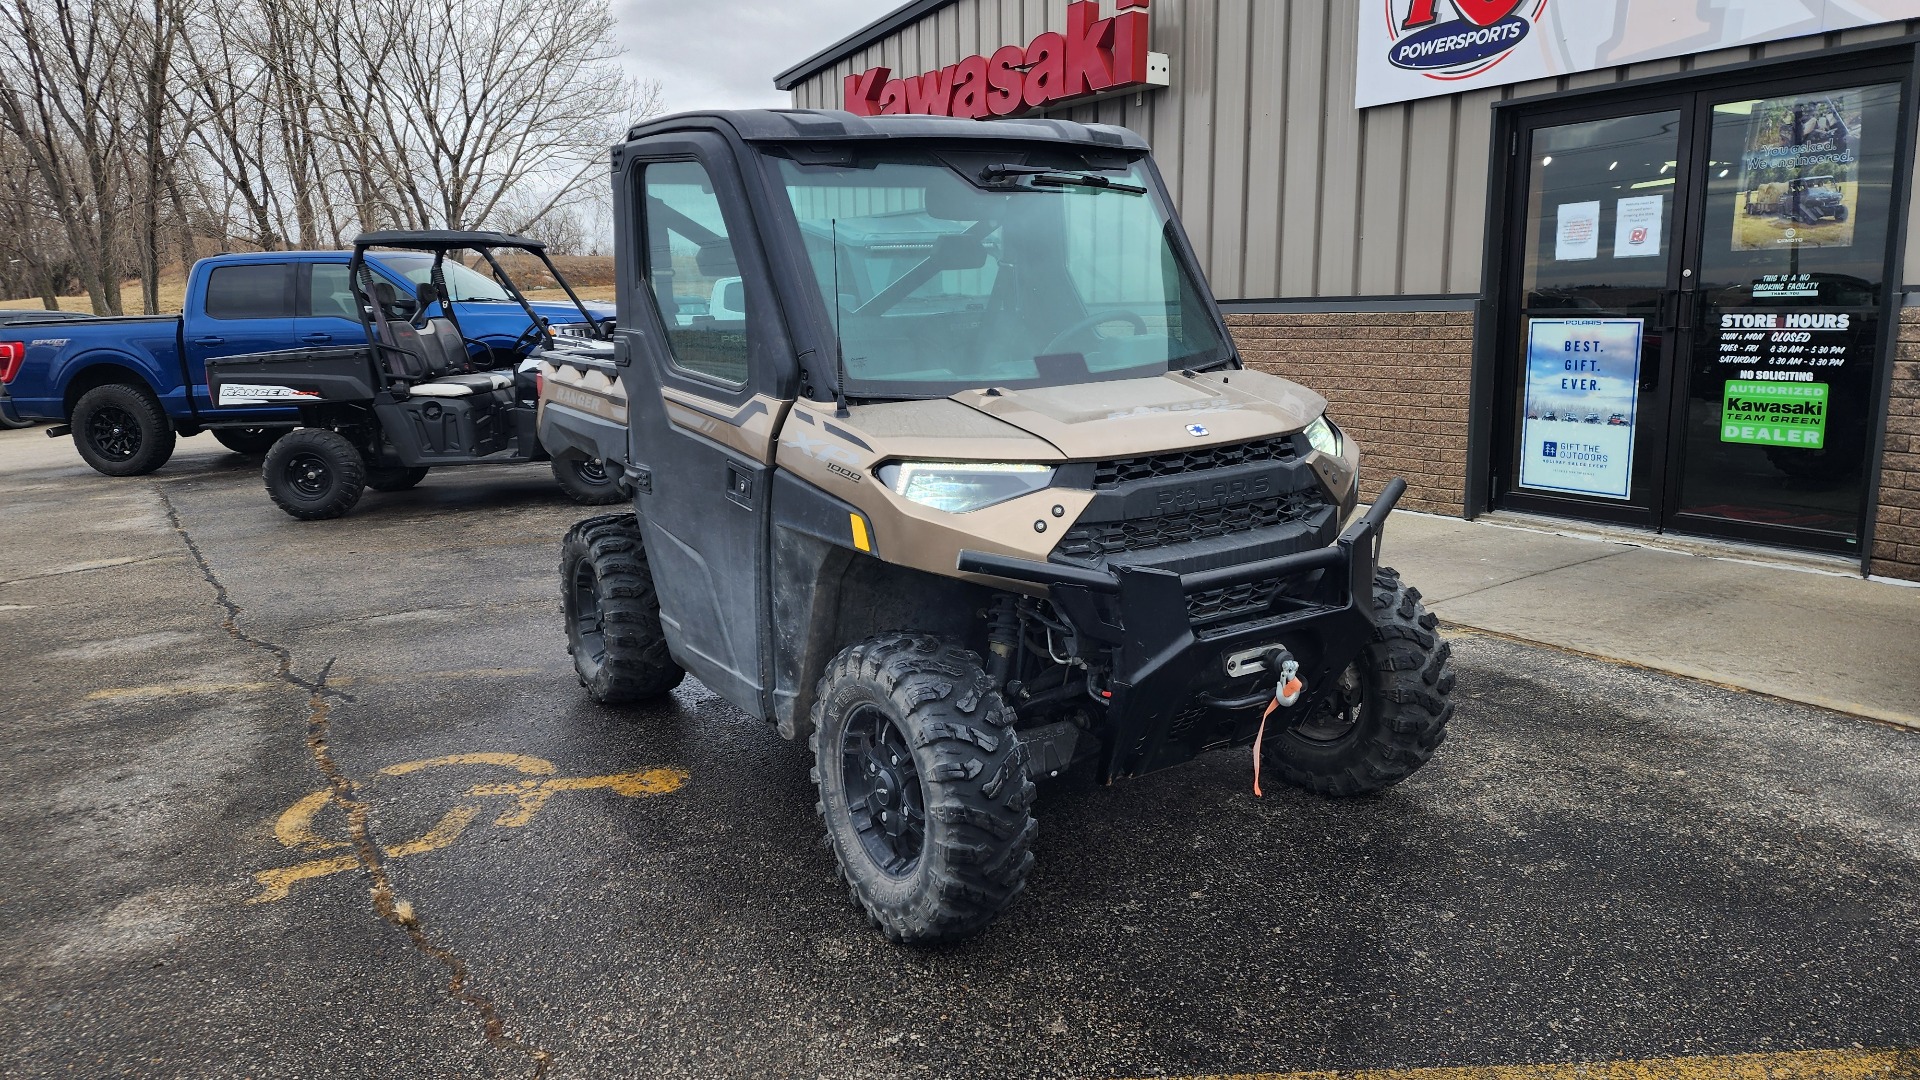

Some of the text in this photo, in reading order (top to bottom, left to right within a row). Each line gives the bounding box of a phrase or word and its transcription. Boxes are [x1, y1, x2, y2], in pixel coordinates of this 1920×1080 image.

[1399, 22, 1522, 60] POWERSPORTS
[844, 0, 1148, 120] Kawasaki
[1762, 138, 1837, 157] You asked.
[1747, 149, 1854, 170] We engineered.
[1763, 273, 1810, 282] THIS IS A NO
[1753, 282, 1819, 290] SMOKING FACILITY
[1721, 314, 1849, 328] STORE HOURS
[31, 338, 71, 347] SPORT
[1744, 333, 1765, 341] MON
[1771, 332, 1811, 343] CLOSED
[1564, 340, 1604, 352] BEST.
[1719, 344, 1739, 352] TUES
[1744, 344, 1759, 352] FRI
[1788, 345, 1804, 354] AM
[1829, 346, 1845, 354] PM
[1564, 359, 1600, 371] GIFT.
[1718, 355, 1761, 364] SATURDAY
[1787, 357, 1803, 365] AM
[1828, 358, 1844, 367] PM
[1740, 370, 1814, 381] NO SOLICITING
[1561, 378, 1601, 391] EVER.
[1728, 385, 1824, 396] AUTHORIZED
[556, 386, 600, 411] RANGER
[1727, 397, 1823, 416] Kawasaki
[1726, 413, 1821, 425] TEAM GREEN
[1724, 425, 1820, 444] DEALER
[782, 431, 860, 465] XP
[1560, 443, 1600, 453] GIFT THE
[1560, 451, 1608, 463] OUTDOORS
[827, 462, 862, 481] 1000
[1155, 474, 1271, 511] POLARIS
